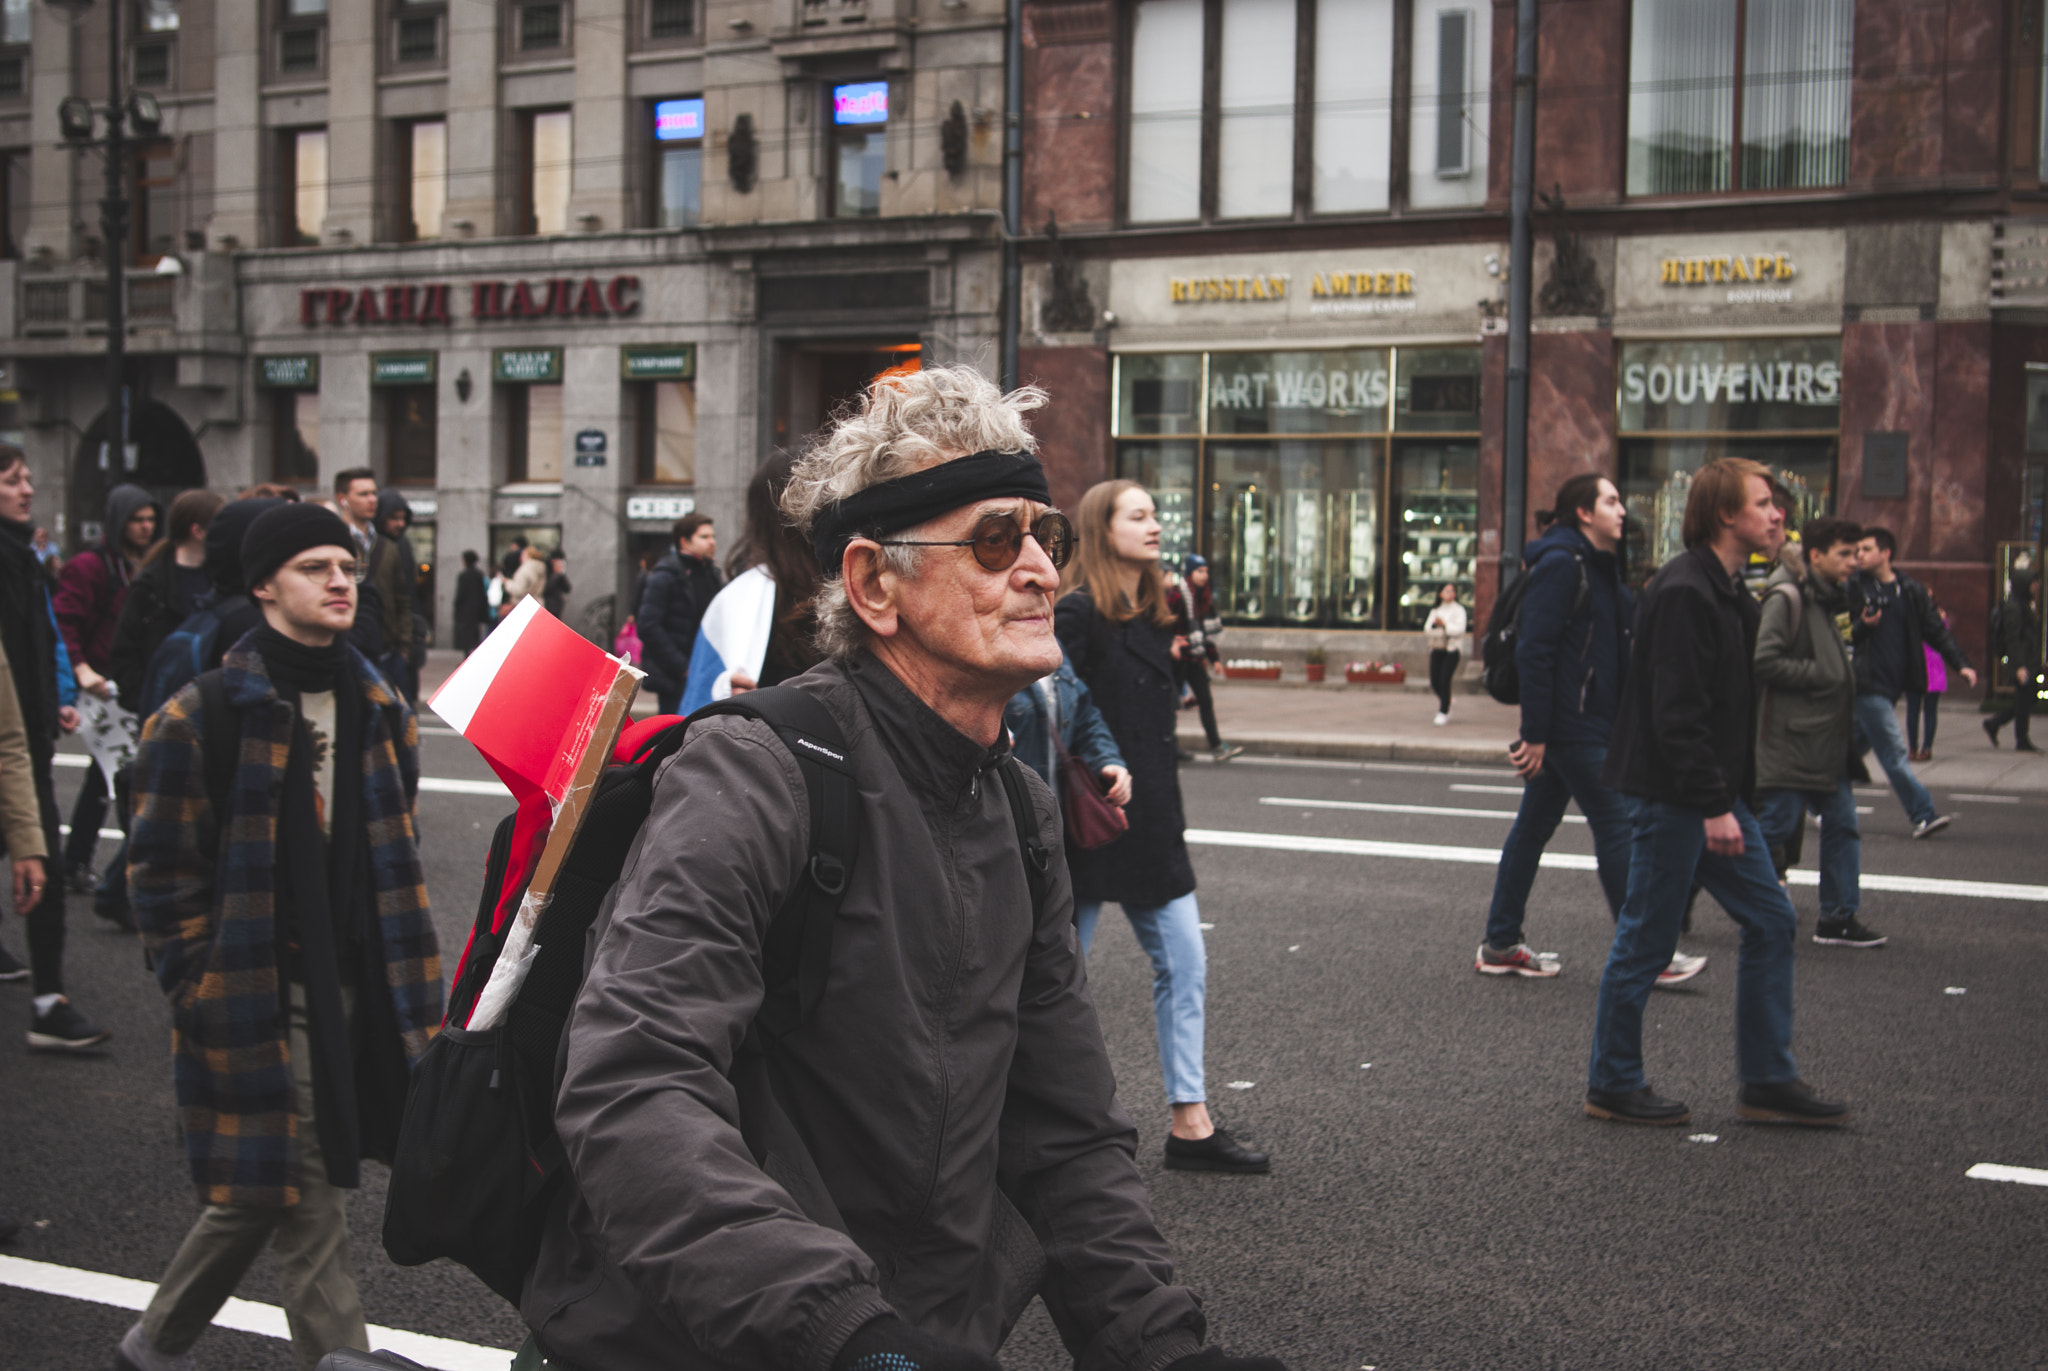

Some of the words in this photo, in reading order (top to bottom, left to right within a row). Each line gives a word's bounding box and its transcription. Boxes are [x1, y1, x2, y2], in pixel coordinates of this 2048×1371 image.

[1168, 275, 1288, 303] RUSSIAN
[1310, 270, 1416, 298] AMBER
[1661, 254, 1795, 285] ЯНТАРЬ
[301, 282, 452, 326] ГРАНД
[471, 275, 641, 321] ПАЛАС
[1211, 372, 1270, 409] ART
[1274, 369, 1390, 408] WORKS
[1624, 361, 1840, 405] SOUVENIRS
[797, 738, 844, 761] AspenSport
